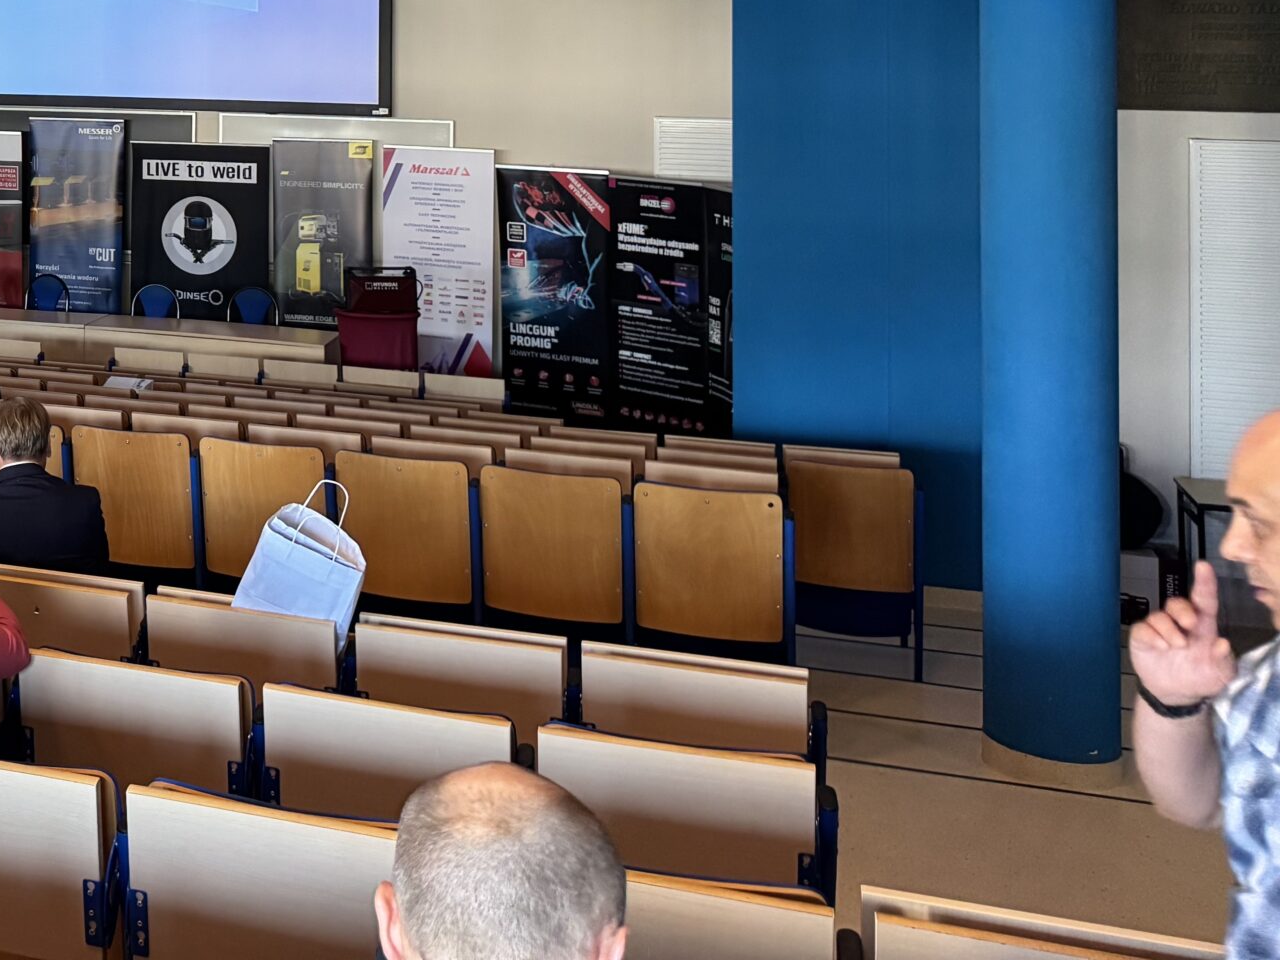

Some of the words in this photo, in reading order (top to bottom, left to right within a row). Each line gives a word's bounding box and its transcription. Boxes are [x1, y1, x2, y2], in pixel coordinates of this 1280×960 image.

[78, 127, 112, 135] MESSER
[146, 161, 180, 177] LIVE
[186, 162, 205, 178] to
[211, 164, 253, 180] weld
[279, 180, 321, 188] ENGINEERED
[175, 289, 209, 301] DINSE
[284, 313, 314, 322] WARRIOR
[315, 315, 334, 323] EDGE
[509, 321, 556, 337] LINCGUN
[509, 334, 552, 349] PROMIG
